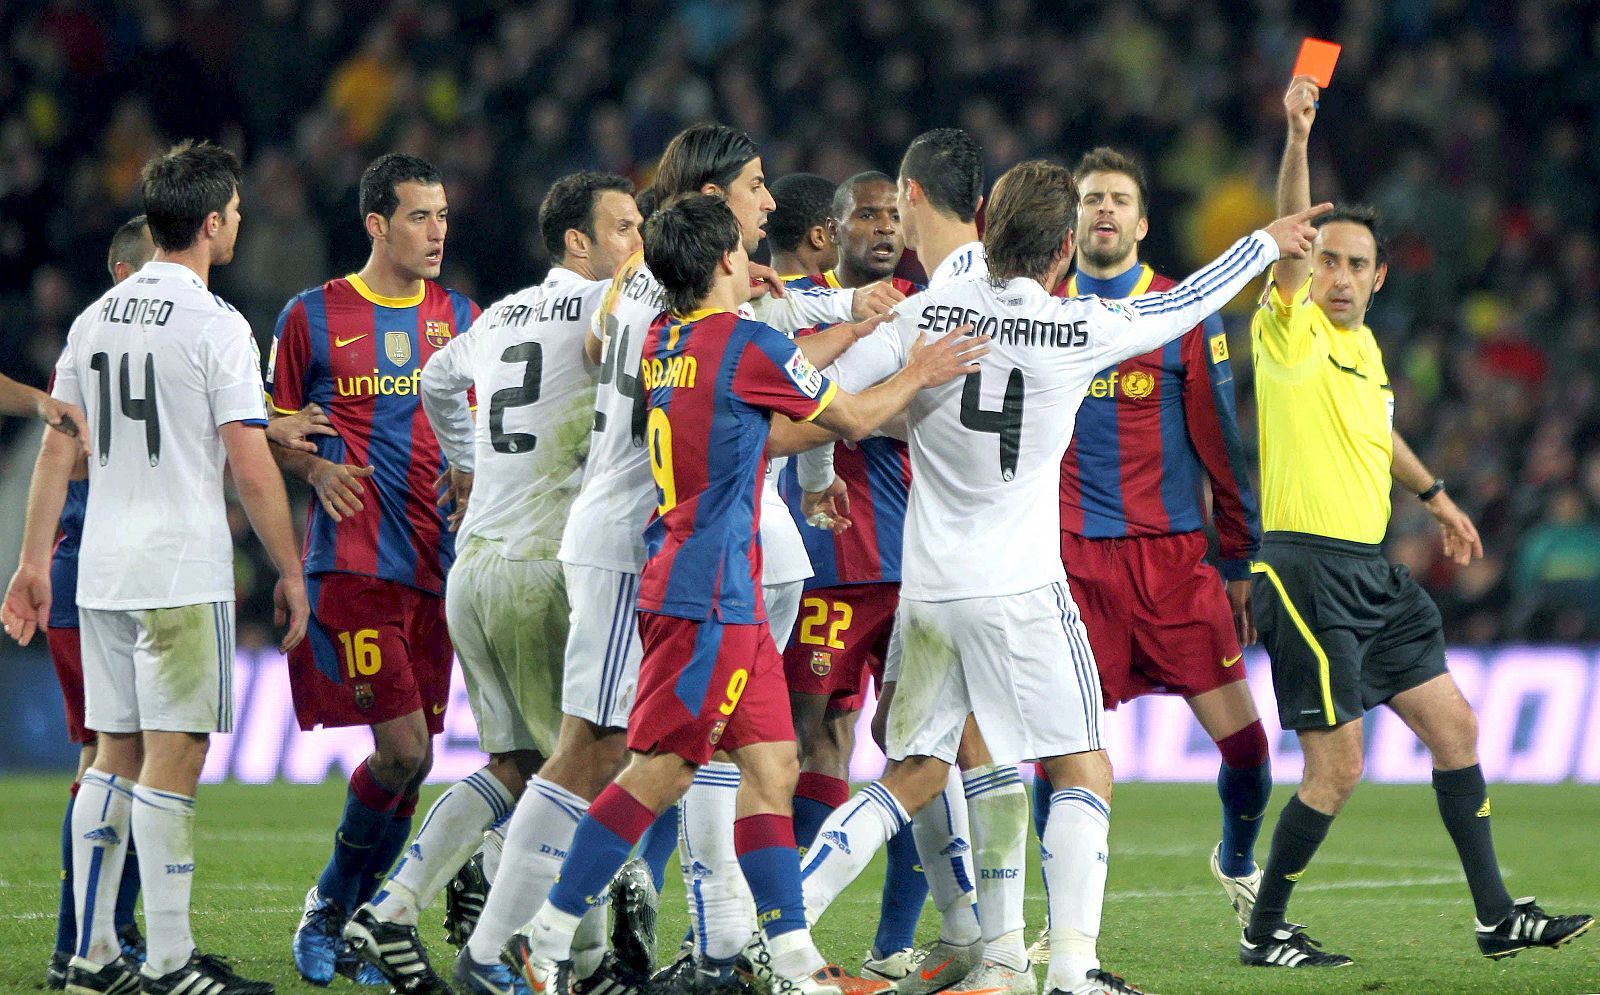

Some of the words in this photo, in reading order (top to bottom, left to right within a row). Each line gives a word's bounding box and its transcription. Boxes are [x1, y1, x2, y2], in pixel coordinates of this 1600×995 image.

[100, 297, 174, 327] ALONSO
[337, 368, 422, 397] unicef
[490, 341, 543, 454] 2
[642, 356, 698, 391] BOJAN
[90, 351, 161, 468] 14
[960, 361, 1025, 482] 4
[647, 407, 677, 517] 9
[800, 597, 854, 650] 22
[338, 628, 382, 678] 16
[719, 667, 749, 716] 9
